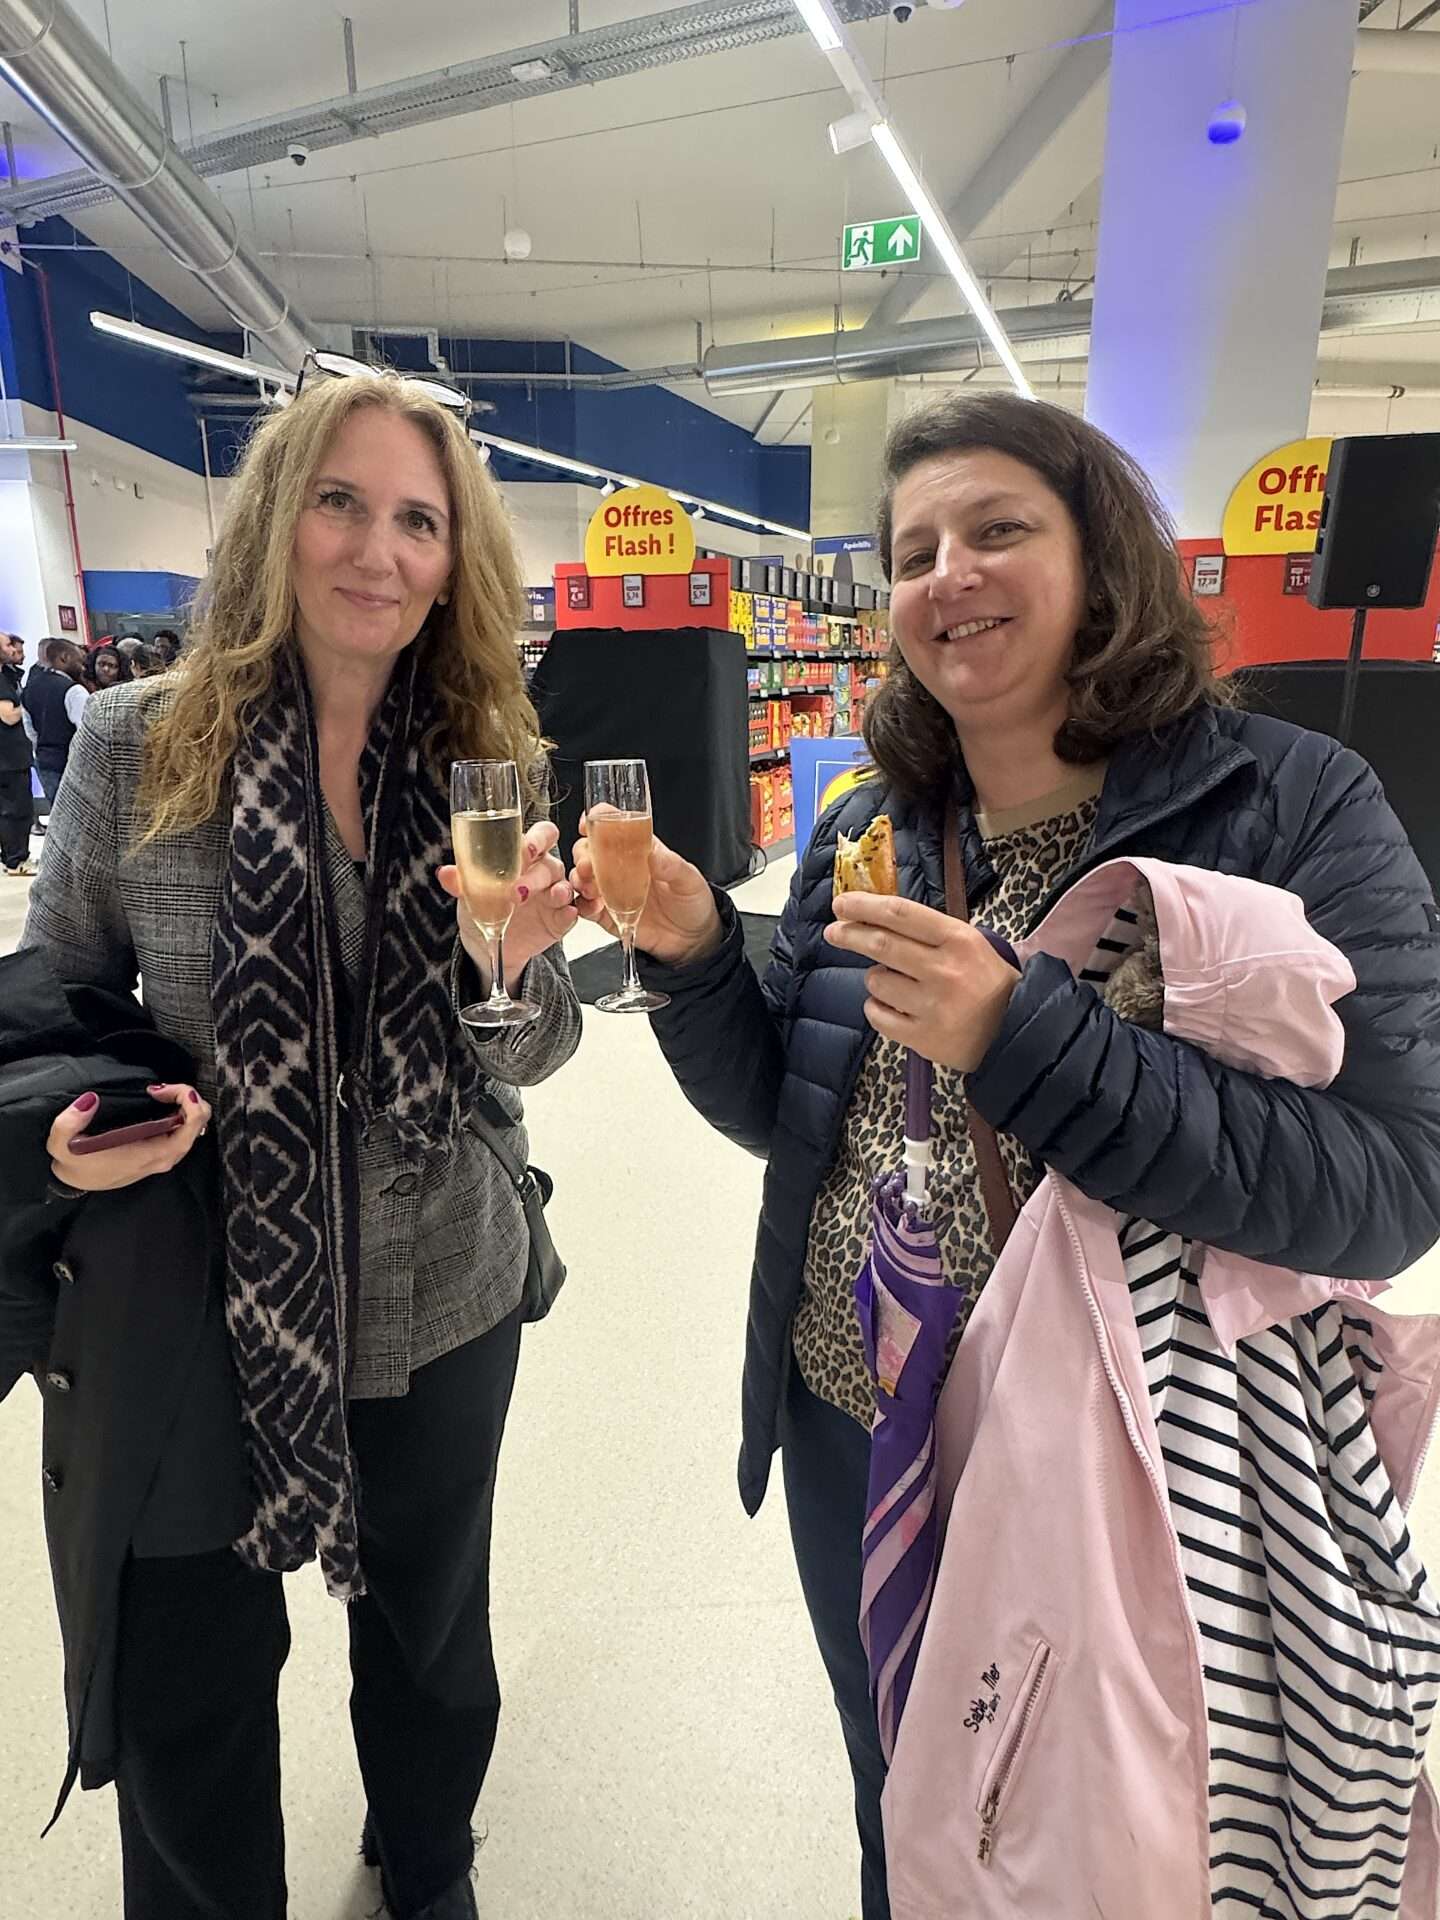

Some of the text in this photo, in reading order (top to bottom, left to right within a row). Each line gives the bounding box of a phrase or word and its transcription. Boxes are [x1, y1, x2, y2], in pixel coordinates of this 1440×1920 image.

[1258, 464, 1327, 495] Offr
[604, 504, 673, 528] Offres
[1254, 503, 1321, 532] Flas
[605, 532, 675, 556] Flash !
